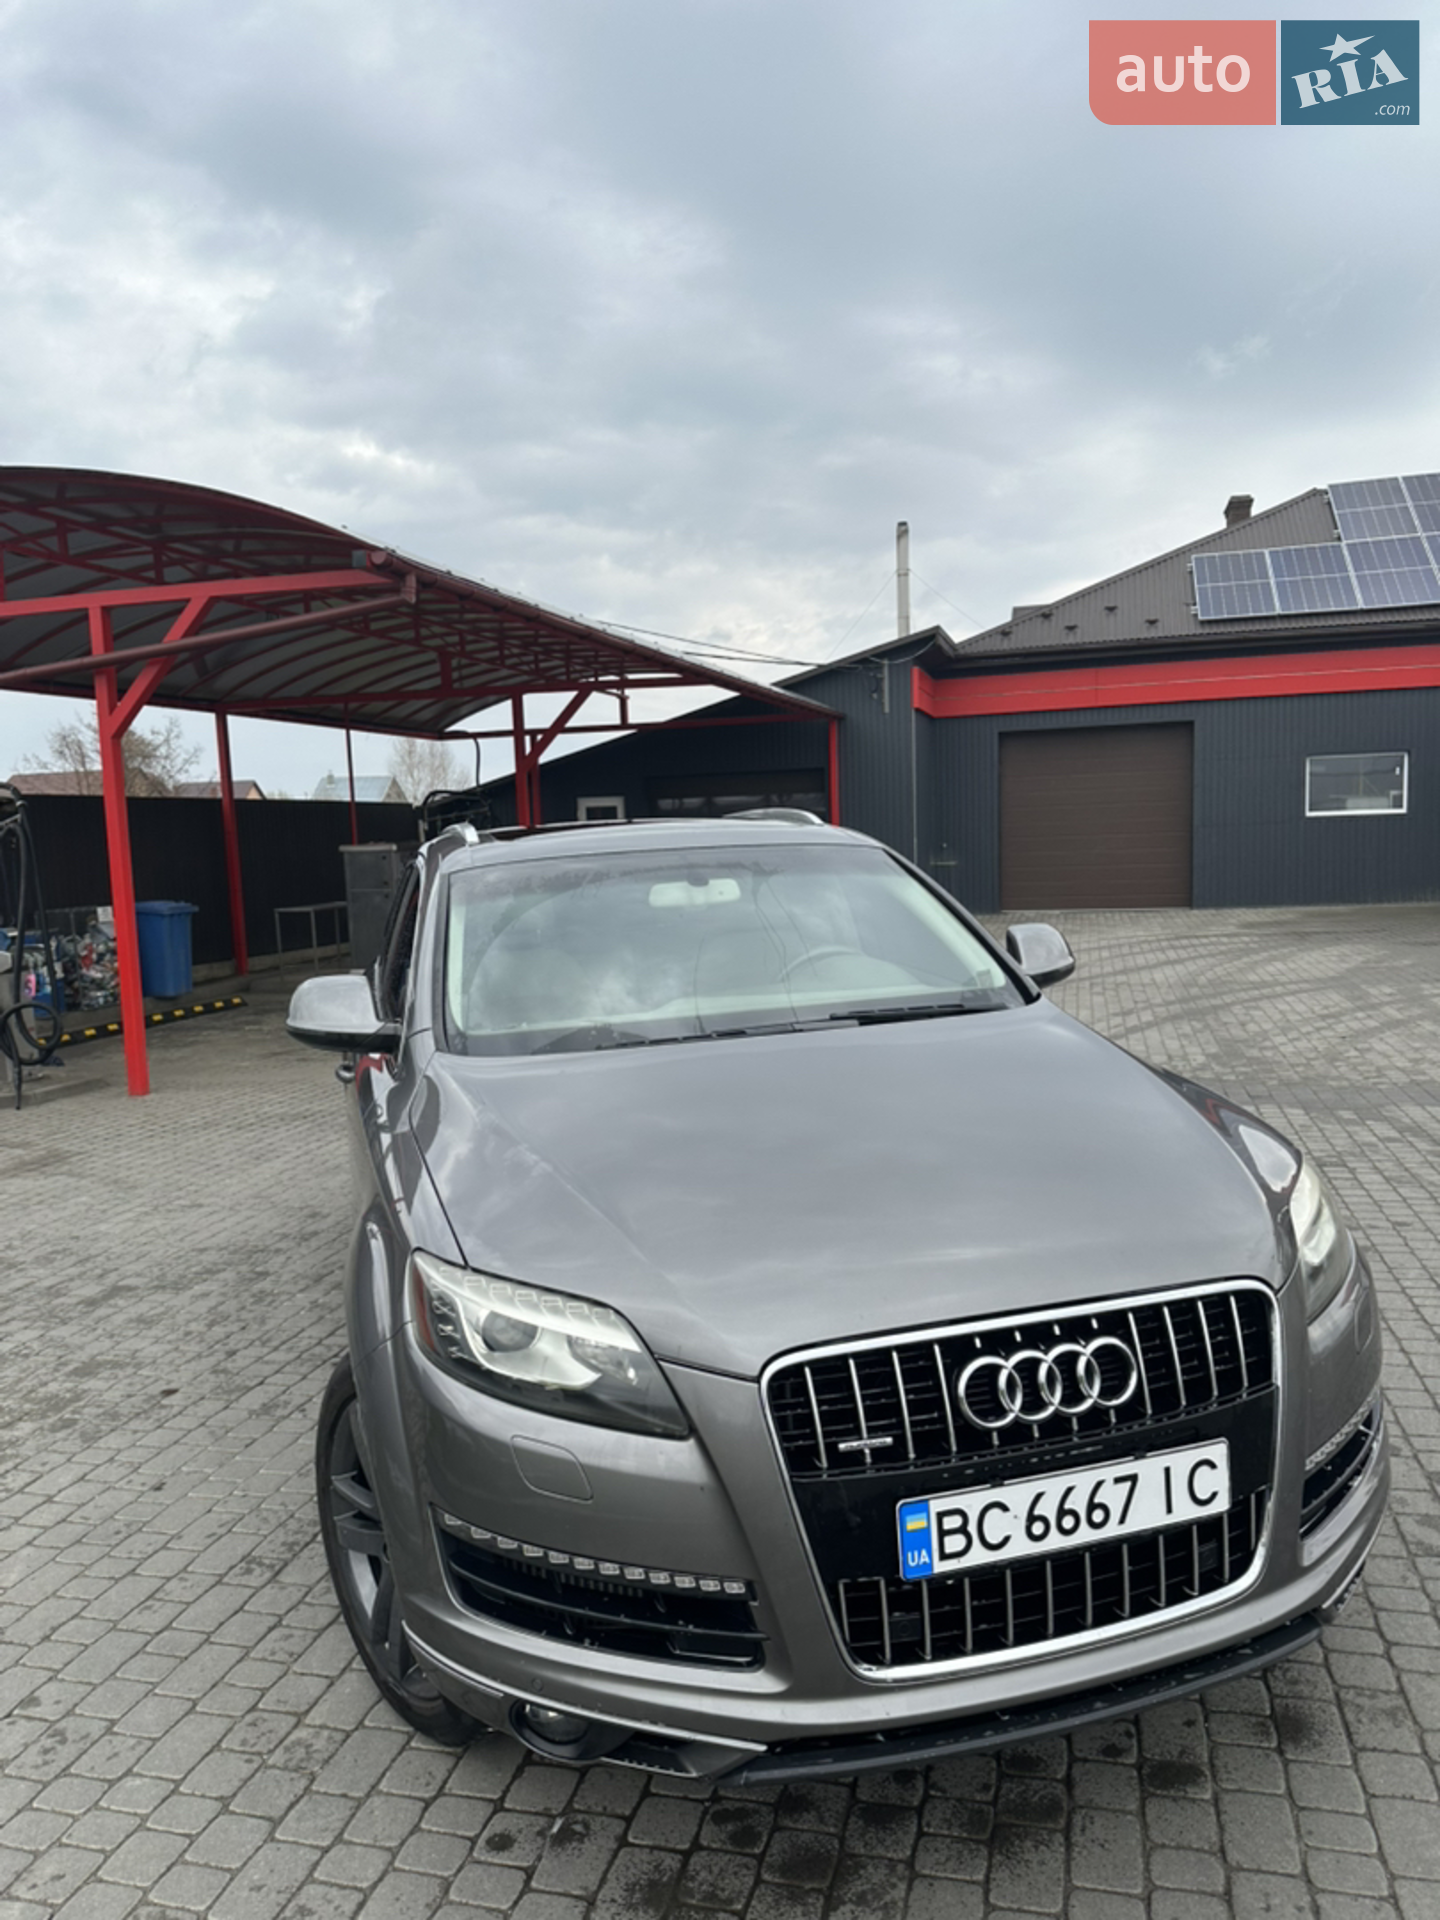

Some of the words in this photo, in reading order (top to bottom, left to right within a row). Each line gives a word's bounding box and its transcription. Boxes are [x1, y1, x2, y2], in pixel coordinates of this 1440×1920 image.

[935, 1500, 1012, 1562] BC
[1024, 1472, 1139, 1542] 6667
[1163, 1458, 1219, 1515] IC
[906, 1549, 931, 1568] UA
